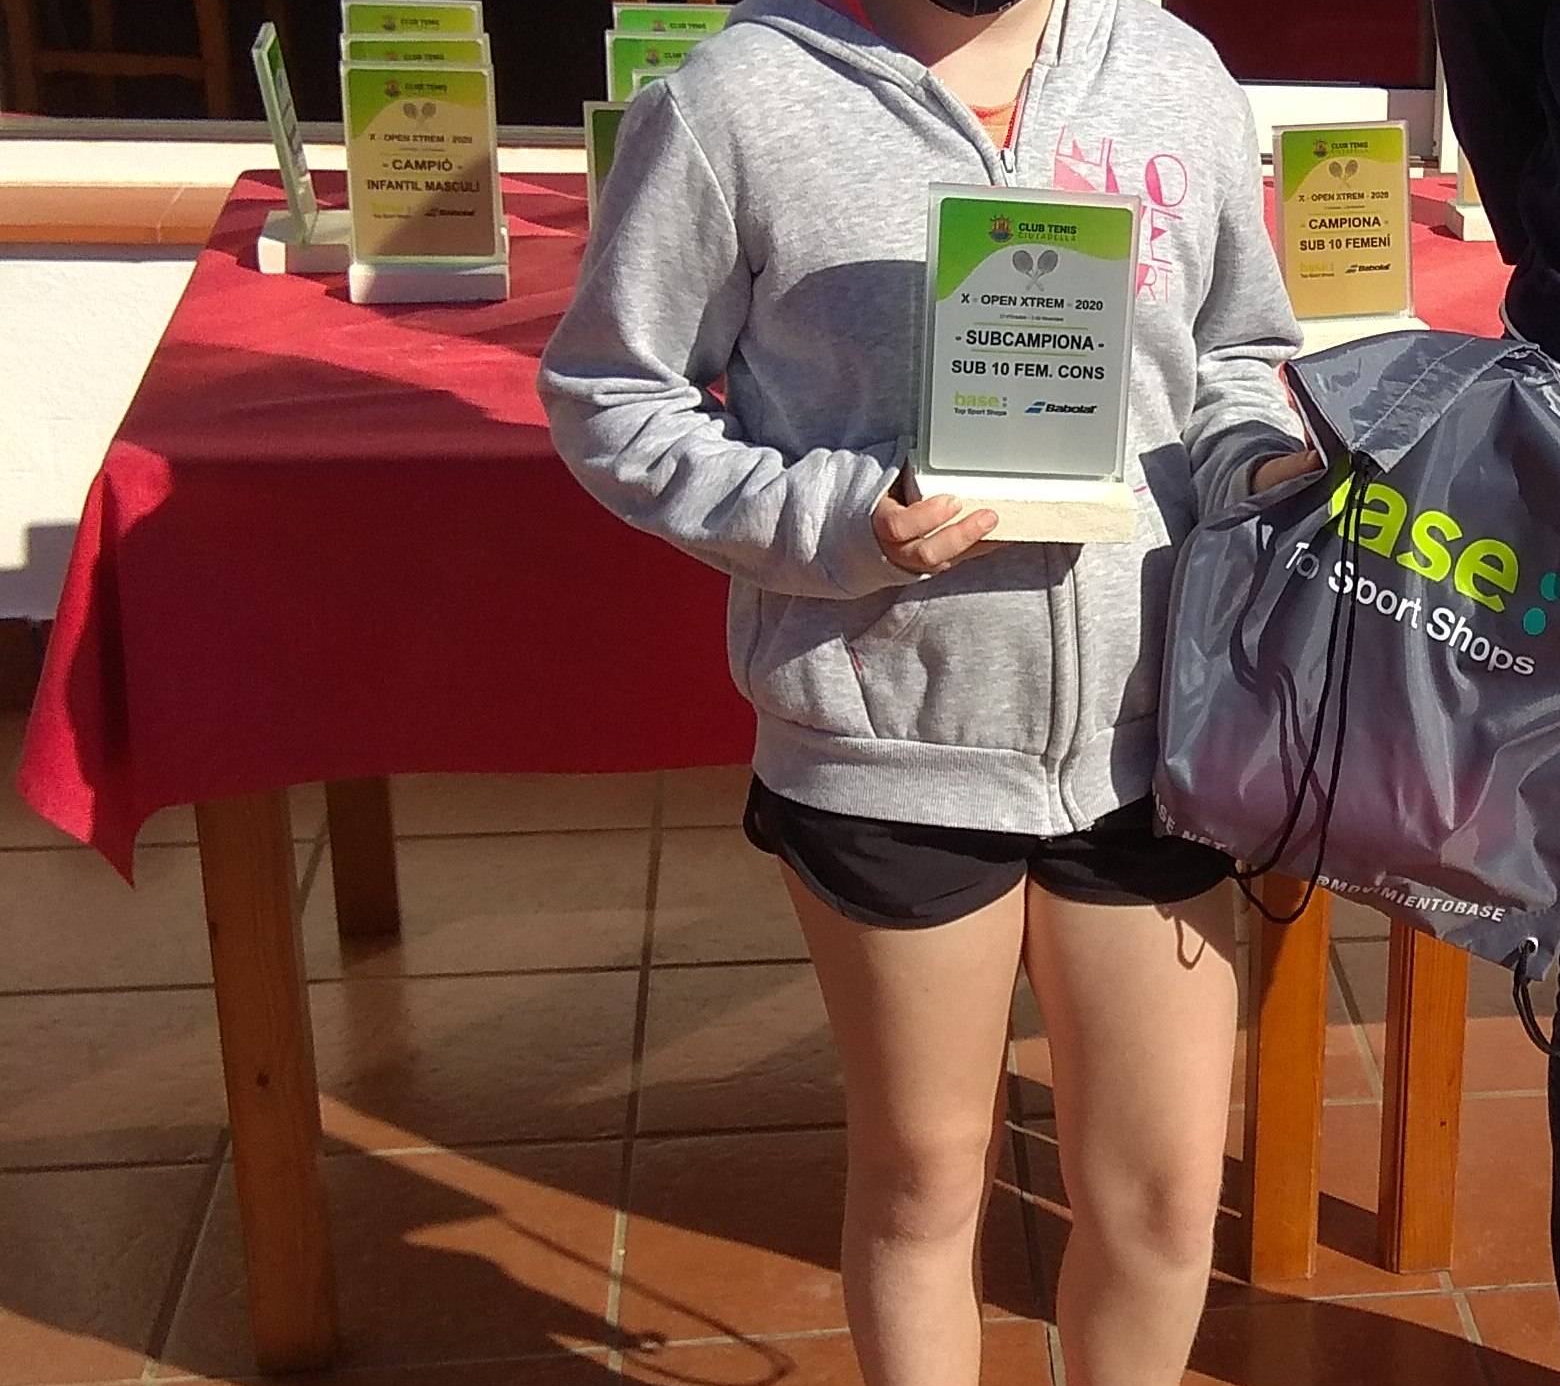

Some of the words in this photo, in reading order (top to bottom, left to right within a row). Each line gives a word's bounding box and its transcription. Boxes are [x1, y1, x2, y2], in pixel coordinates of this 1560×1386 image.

[391, 158, 454, 172] CAMPIÓ
[367, 179, 422, 192] INFANTIL
[1311, 193, 1335, 202] OPEN
[1336, 192, 1365, 201] XTREM
[1018, 222, 1045, 232] CLUB
[1048, 224, 1078, 235] TENIS
[1308, 216, 1382, 230] CAMPIONA
[1299, 239, 1326, 251] SUB
[1328, 238, 1342, 250] 10
[1345, 233, 1391, 249] FEMENÍ
[960, 293, 970, 304] X
[981, 294, 1017, 306] OPEN
[1020, 296, 1065, 309] XTREM
[1075, 299, 1104, 311] 2020
[966, 329, 1095, 351] SUBCAMPIONA
[951, 360, 986, 375] SUB
[991, 361, 1010, 376] 10
[1014, 363, 1053, 378] FEM.
[1058, 365, 1105, 380] CONS
[1328, 560, 1422, 630] Sport
[1426, 606, 1536, 676] Shops
